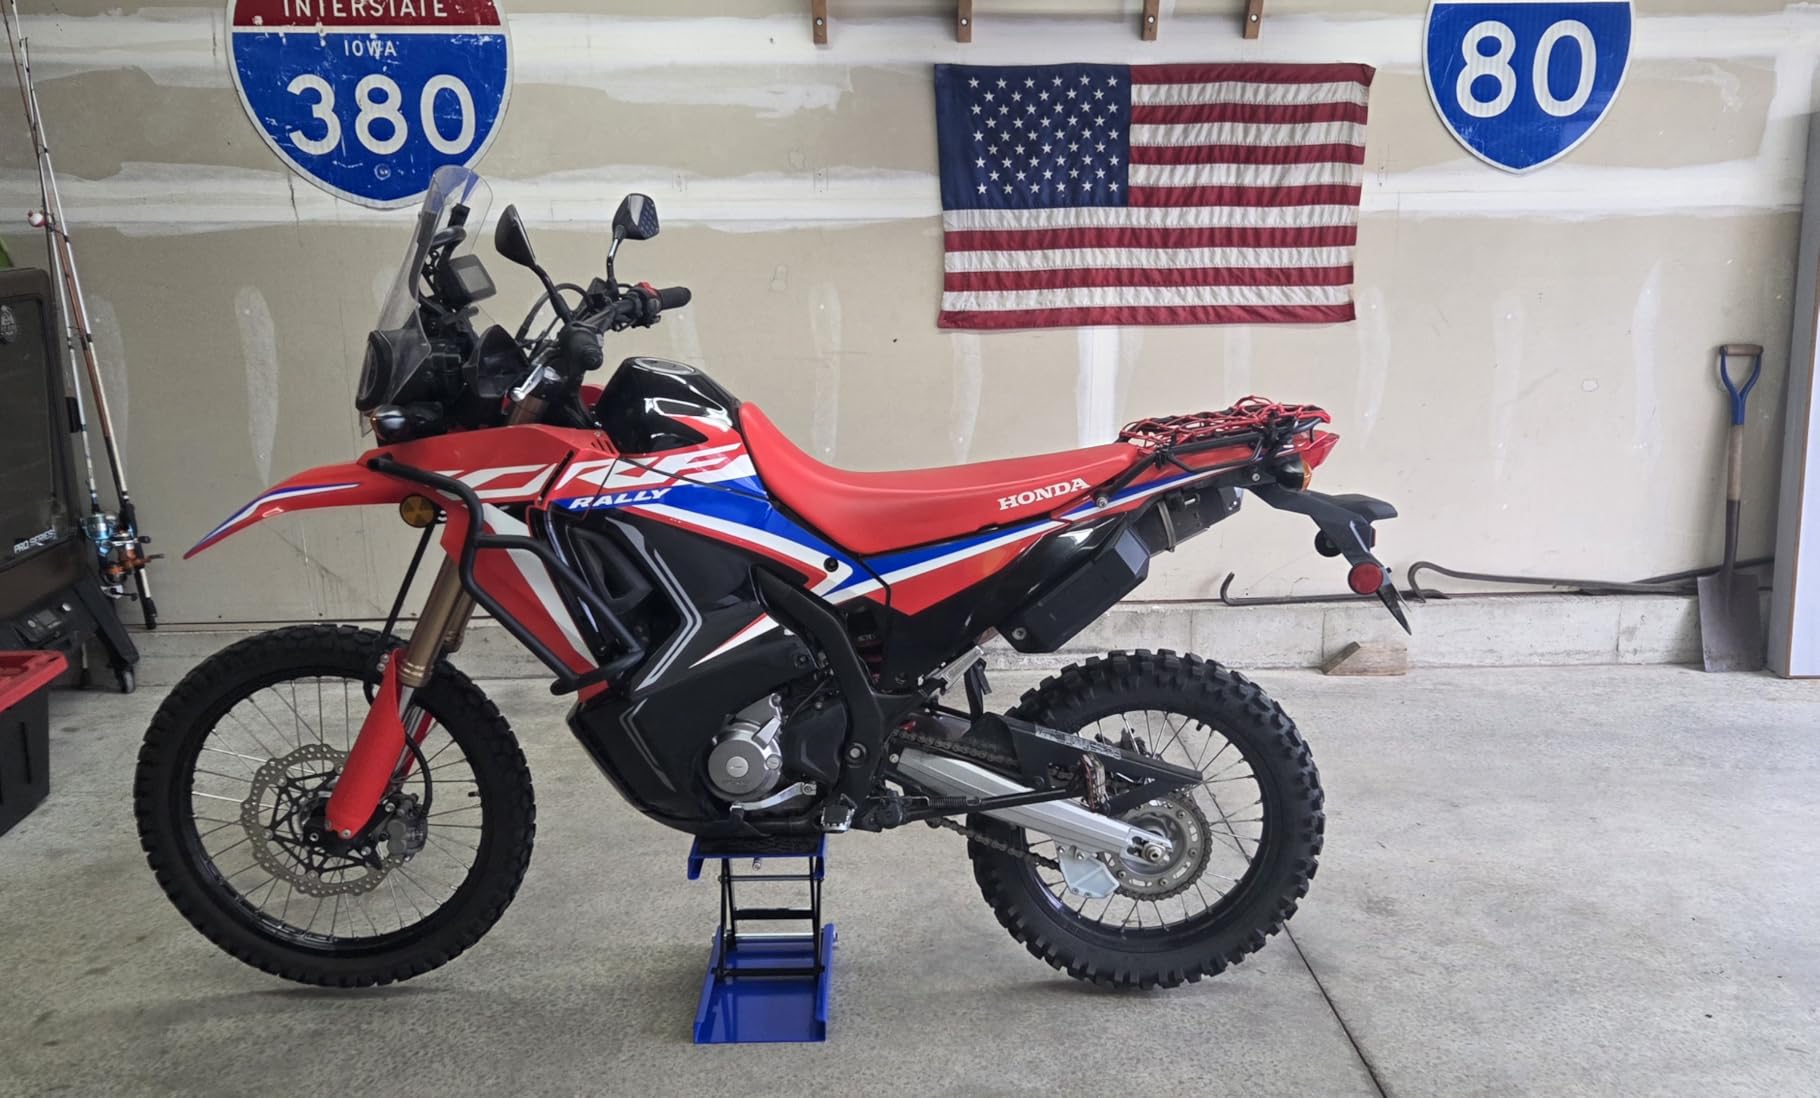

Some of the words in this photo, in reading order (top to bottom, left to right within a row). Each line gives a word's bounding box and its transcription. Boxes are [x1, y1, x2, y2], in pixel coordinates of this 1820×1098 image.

[283, 0, 448, 17] INTERSTATE
[344, 39, 397, 58] IOWA
[1456, 19, 1597, 118] 80
[287, 73, 476, 155] 380
[568, 487, 672, 509] RALLY
[997, 477, 1091, 511] HONDA
[13, 540, 29, 554] PRO
